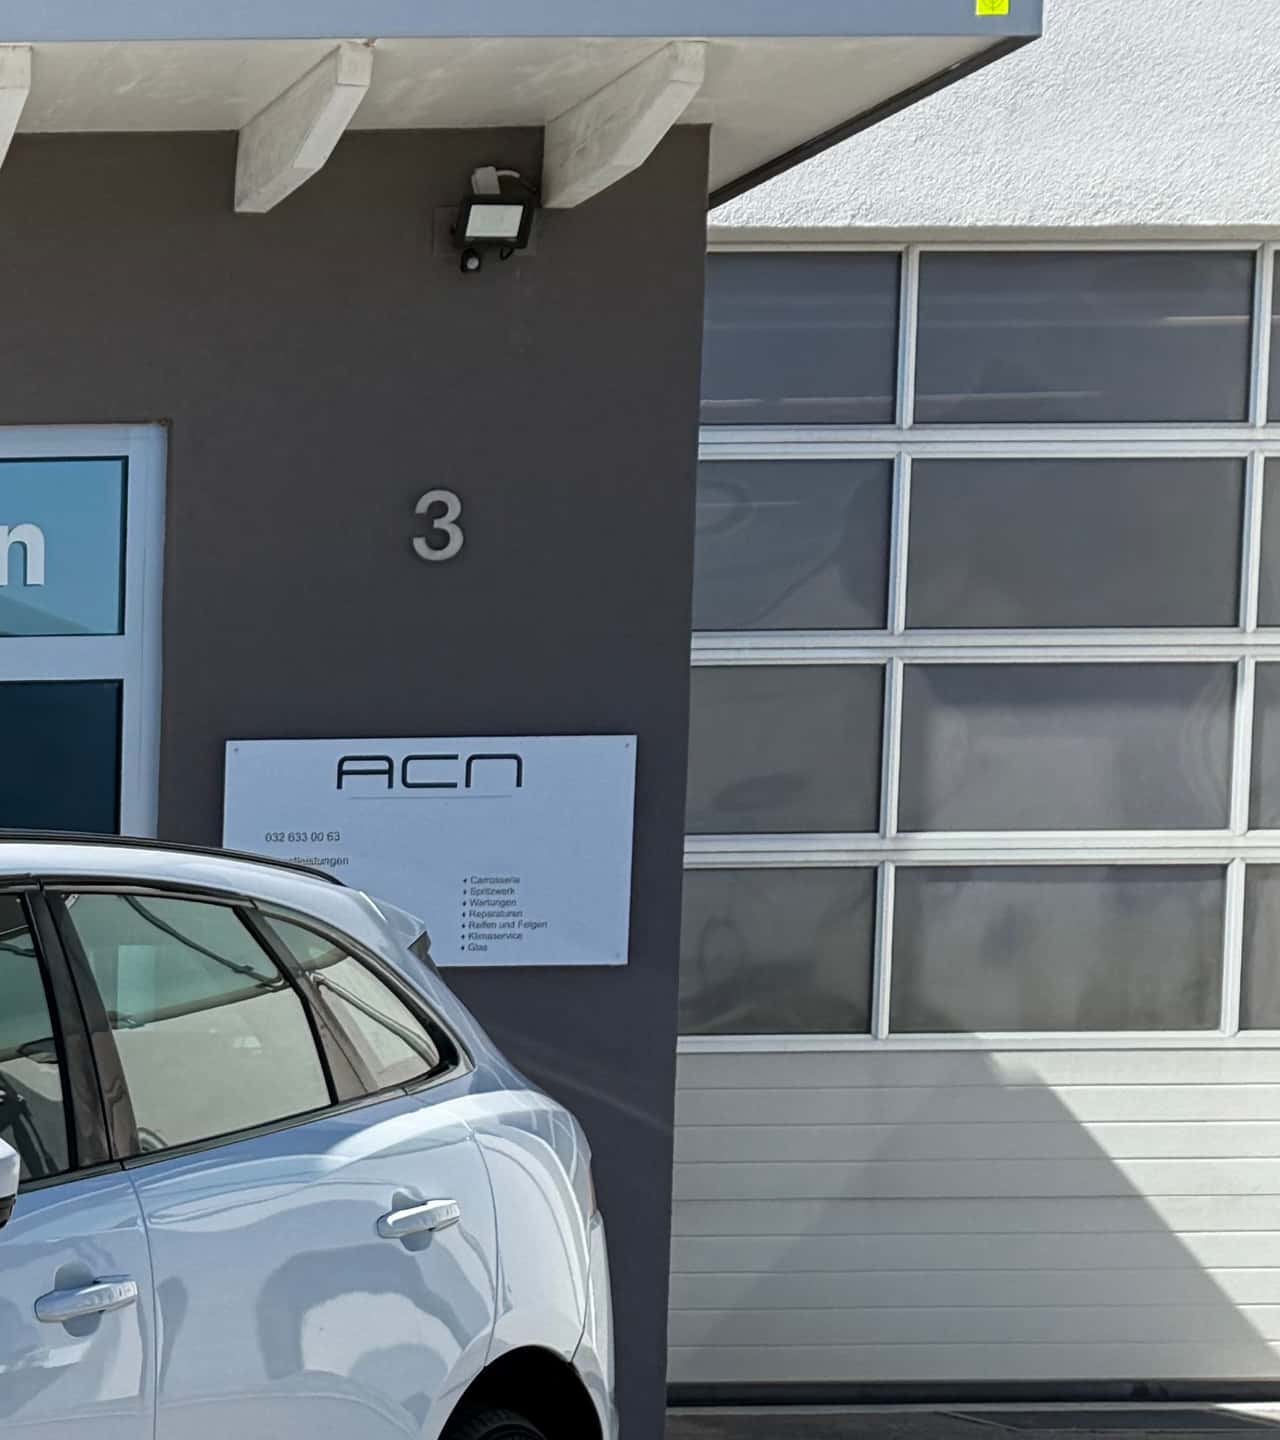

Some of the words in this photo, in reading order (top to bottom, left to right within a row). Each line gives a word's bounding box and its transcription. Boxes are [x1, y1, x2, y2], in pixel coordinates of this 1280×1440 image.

[413, 489, 464, 561] 3
[336, 753, 523, 789] ACN
[265, 831, 285, 842] 032
[288, 831, 308, 842] 633
[310, 831, 324, 842] 00
[327, 831, 341, 841] 63
[470, 887, 515, 897] Spritzwerk
[470, 899, 517, 908] Wartungen
[468, 910, 523, 919] Reparaturen
[468, 921, 496, 929] Reifen
[499, 921, 515, 929] und
[518, 921, 549, 930] Felgen
[468, 932, 523, 941] Klimaservice
[468, 943, 488, 952] Glas
